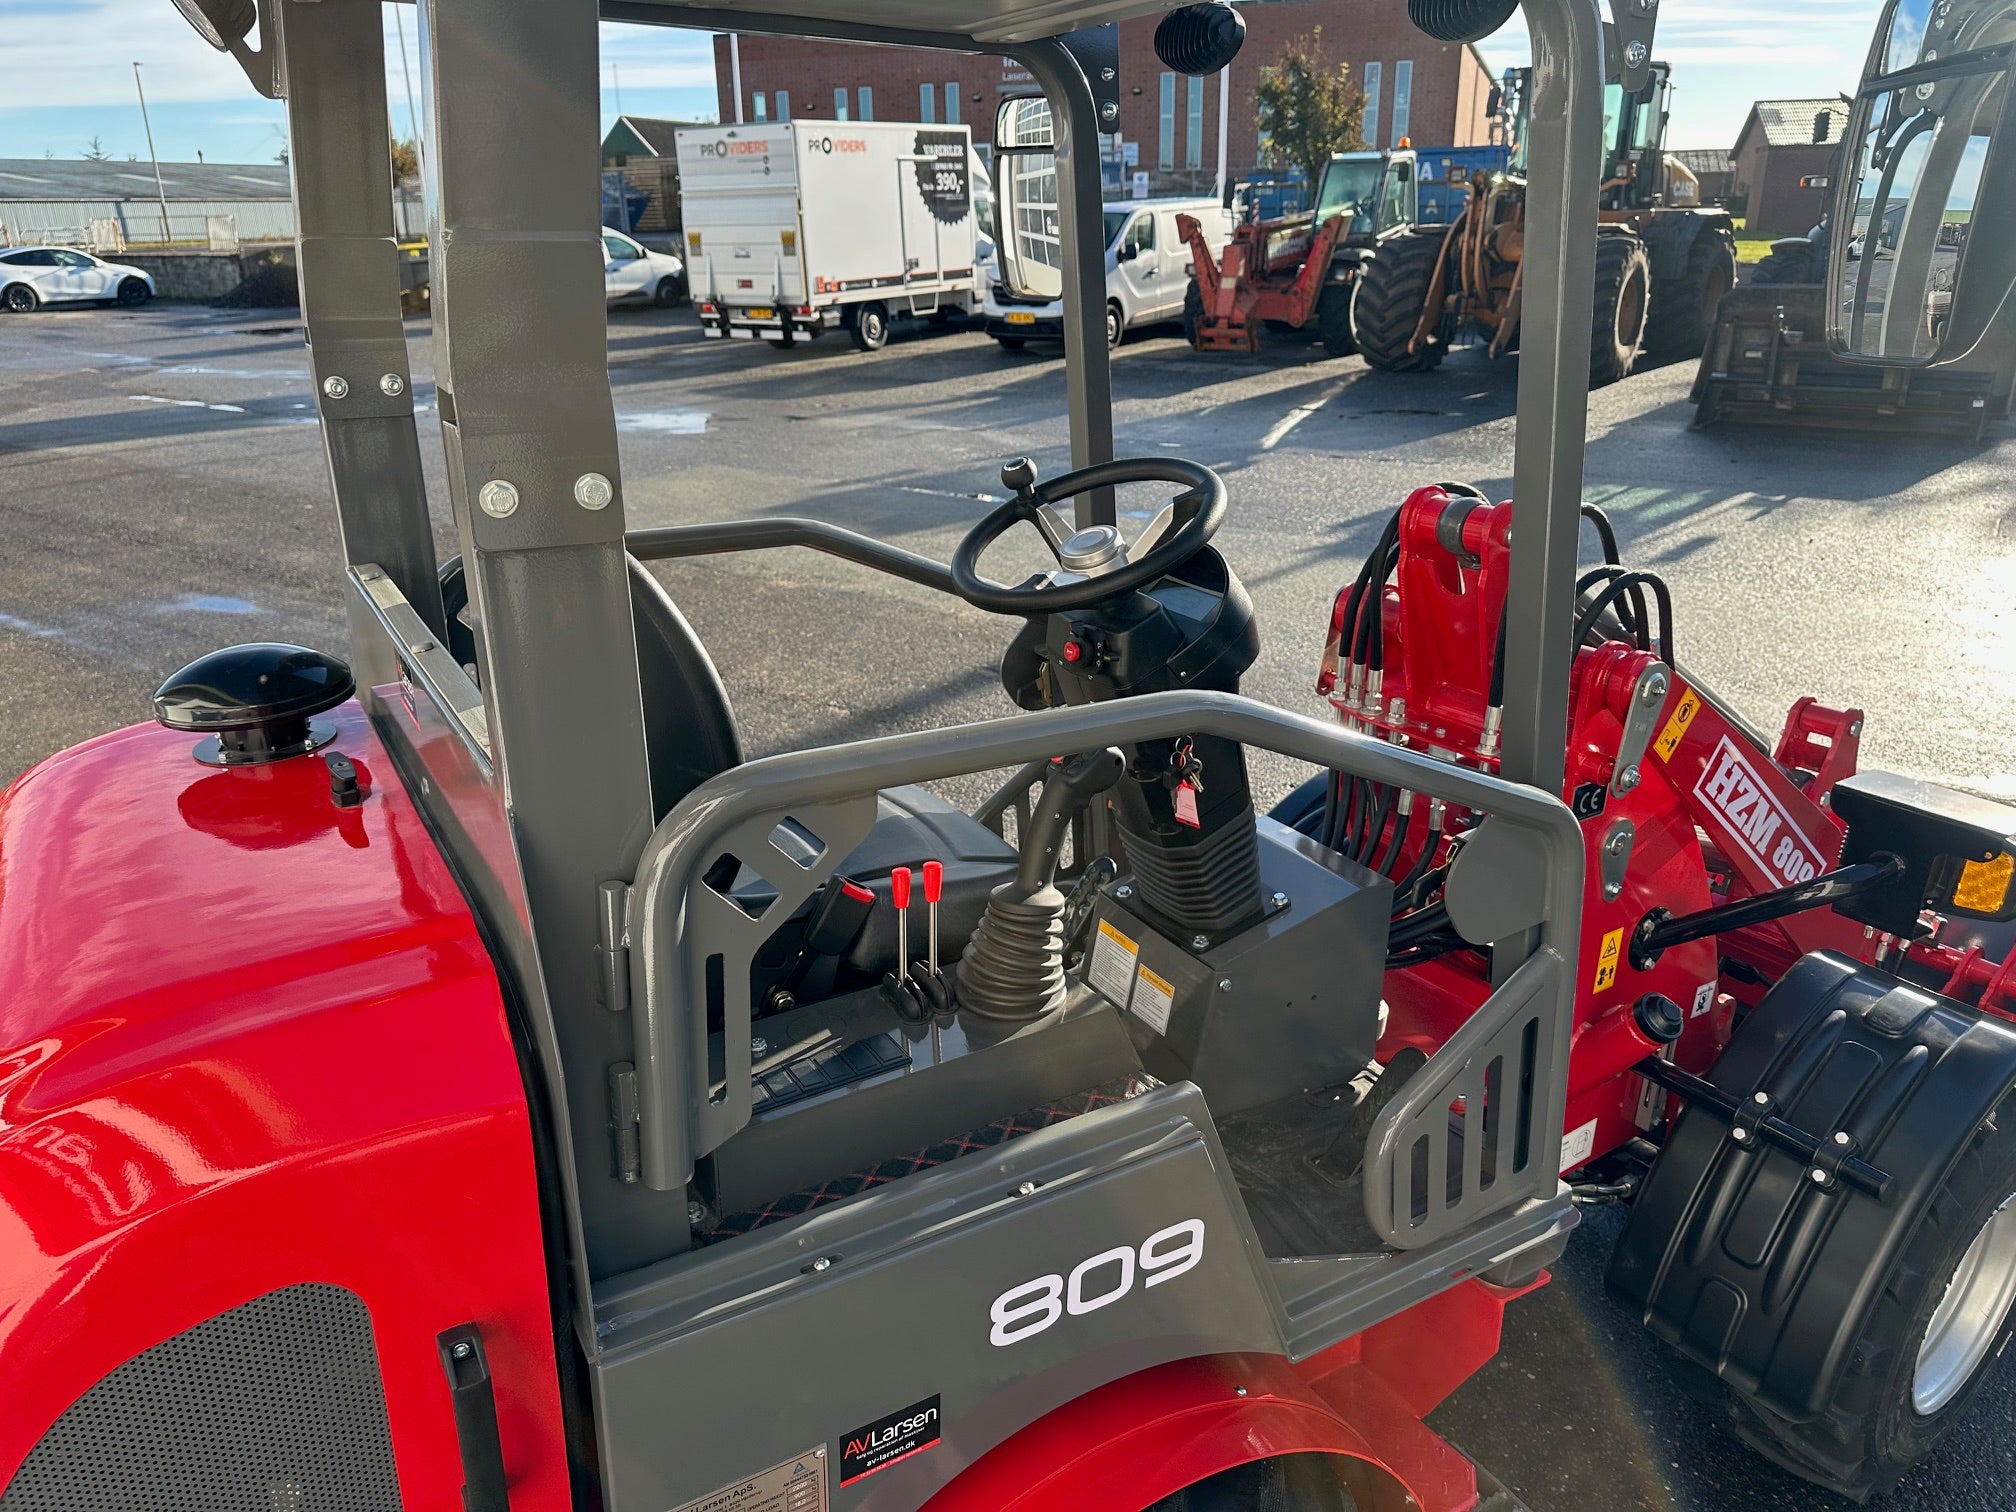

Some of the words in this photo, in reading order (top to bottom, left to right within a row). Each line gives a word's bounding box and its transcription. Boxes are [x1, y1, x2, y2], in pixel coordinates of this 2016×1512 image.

[701, 140, 768, 157] PROVIDERS
[809, 137, 867, 154] PROVIDERS
[1705, 752, 1782, 855] HZM
[1772, 835, 1815, 885] 809
[990, 1218, 1205, 1347] 809
[866, 1440, 916, 1467] av-larsen.dk
